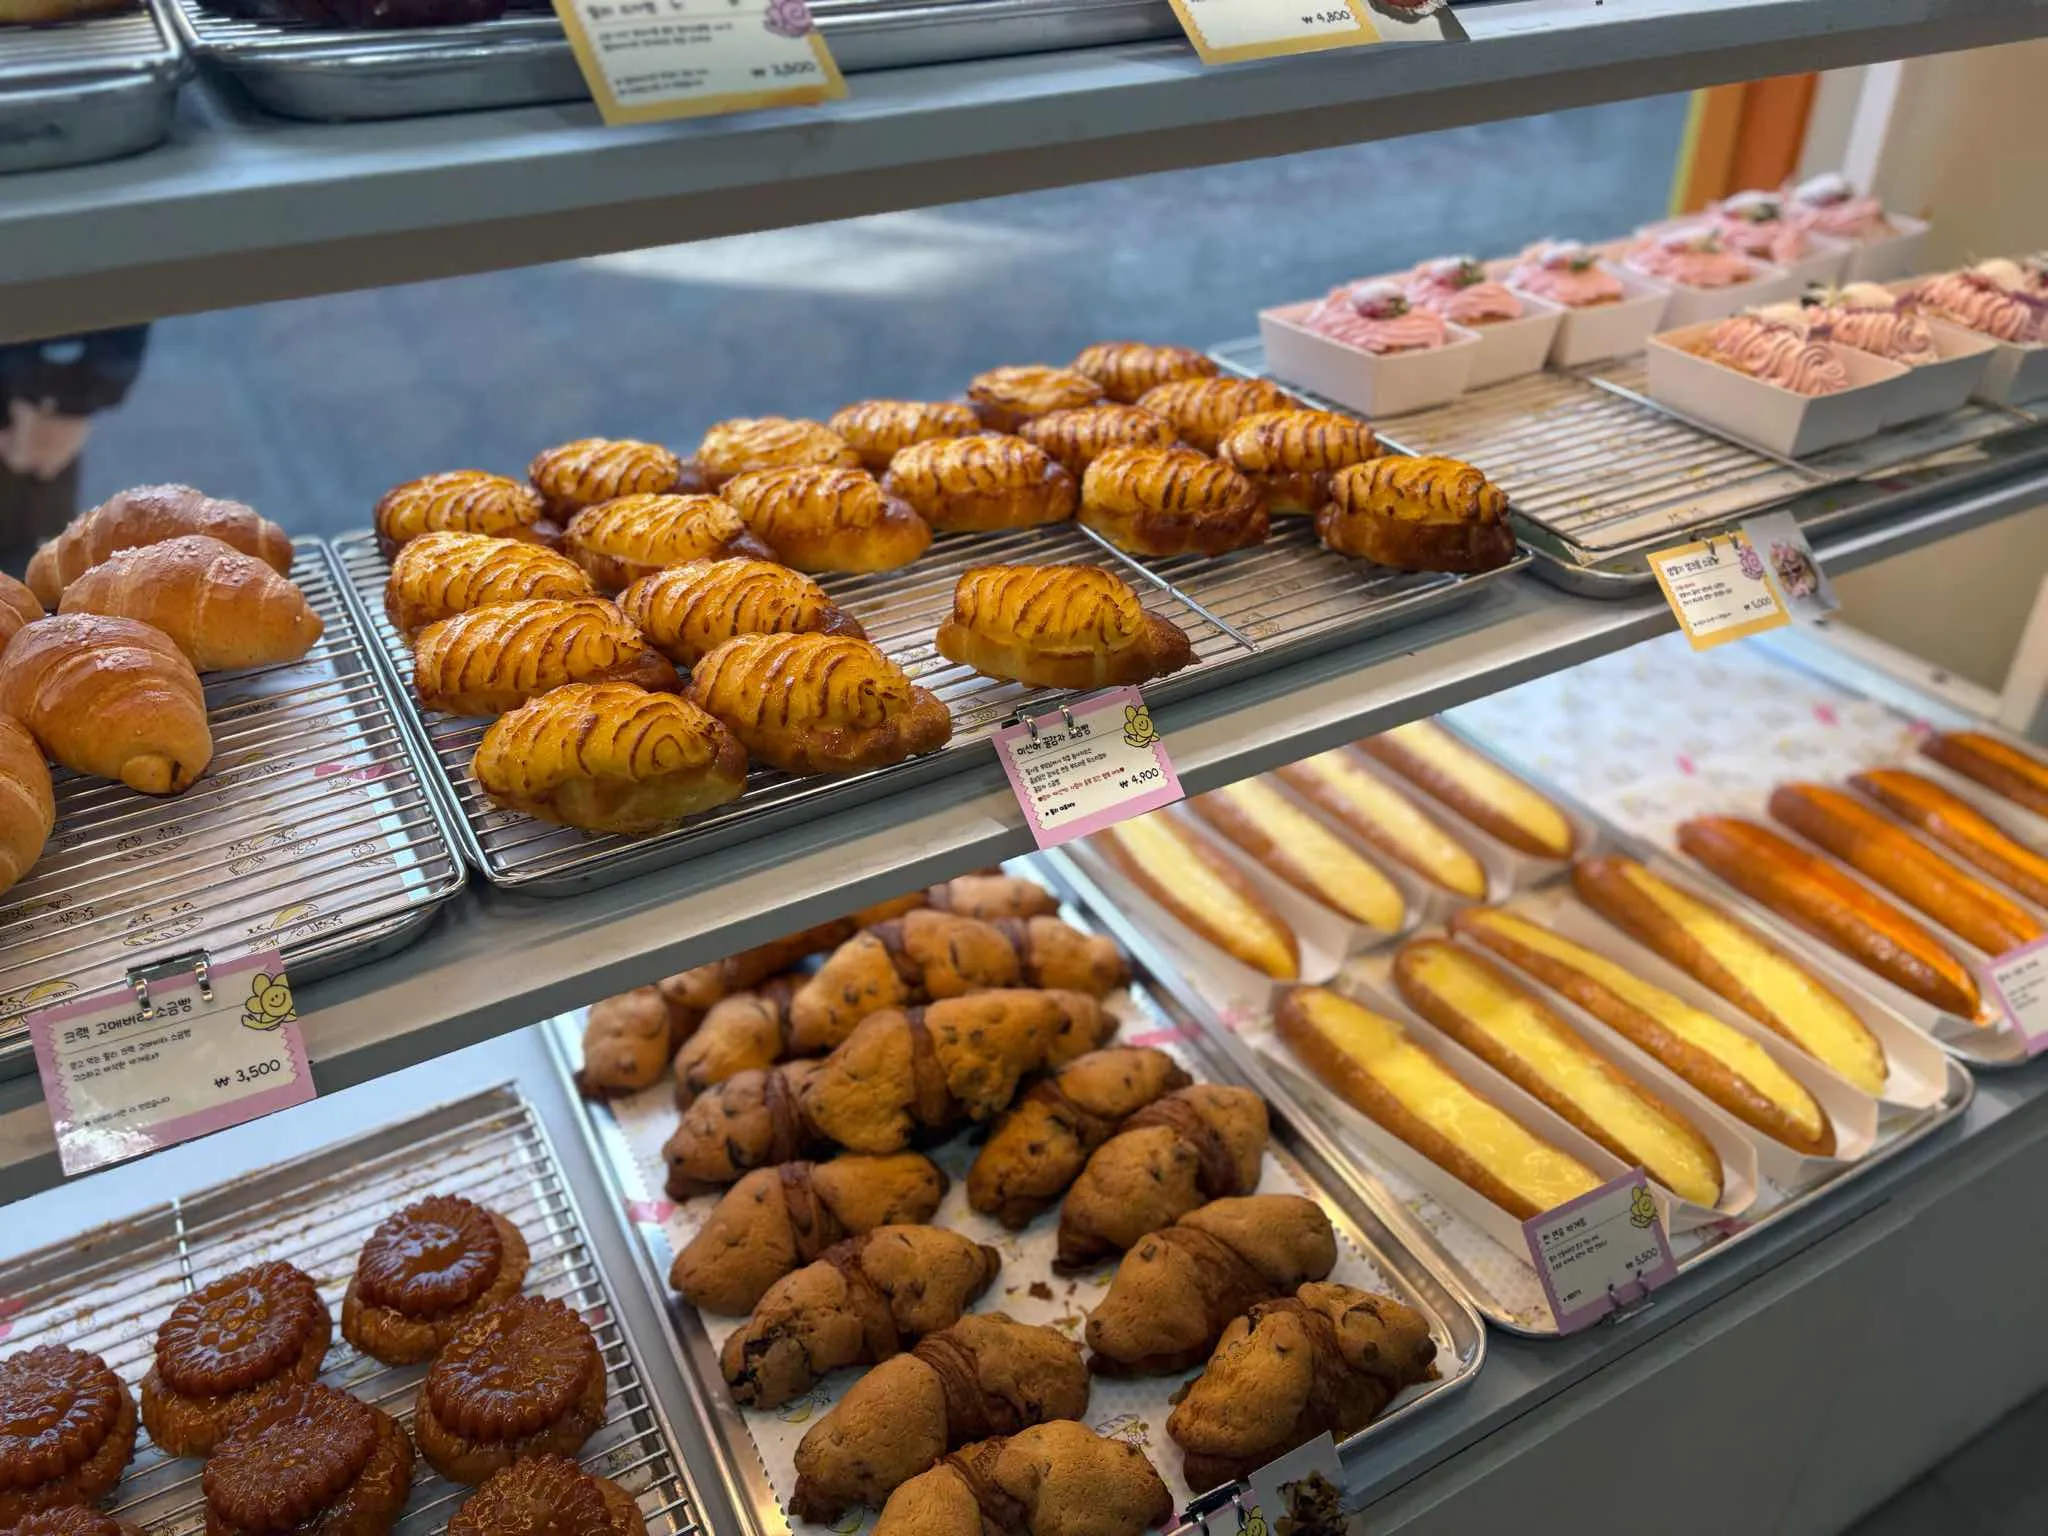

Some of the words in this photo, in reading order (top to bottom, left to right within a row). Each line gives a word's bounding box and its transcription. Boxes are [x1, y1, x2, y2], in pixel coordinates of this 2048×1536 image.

[1131, 768, 1159, 784] 4,900
[156, 997, 192, 1019] 소금빵
[236, 1058, 281, 1084] 3,500
